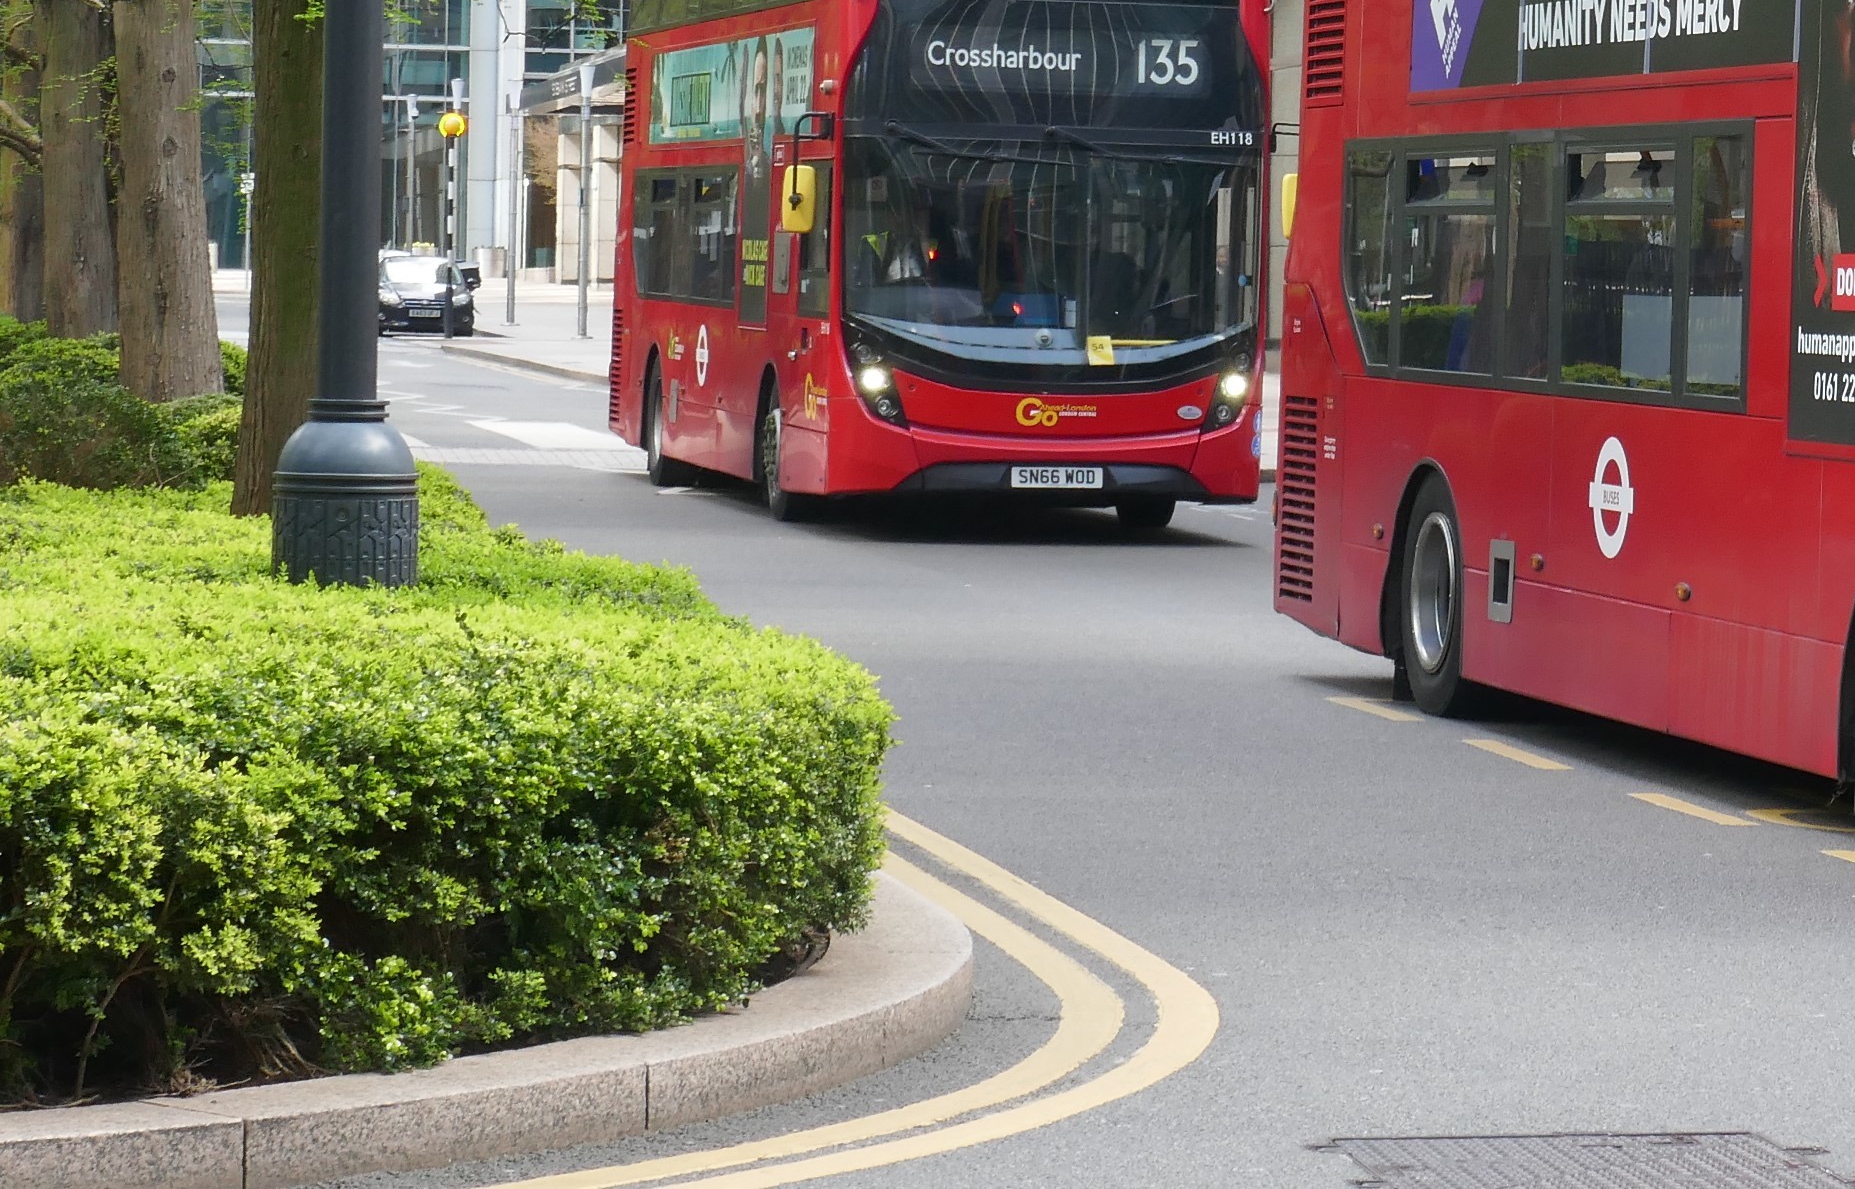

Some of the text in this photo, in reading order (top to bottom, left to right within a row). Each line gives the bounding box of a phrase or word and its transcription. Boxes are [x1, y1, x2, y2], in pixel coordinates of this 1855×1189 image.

[927, 40, 1199, 85] Crossharbour 135
[1210, 132, 1253, 145] EH118
[1814, 372, 1838, 401] 0161
[1016, 397, 1058, 427] Go
[1019, 470, 1095, 484] SN66 WOD
[1603, 490, 1620, 505] BUSES
